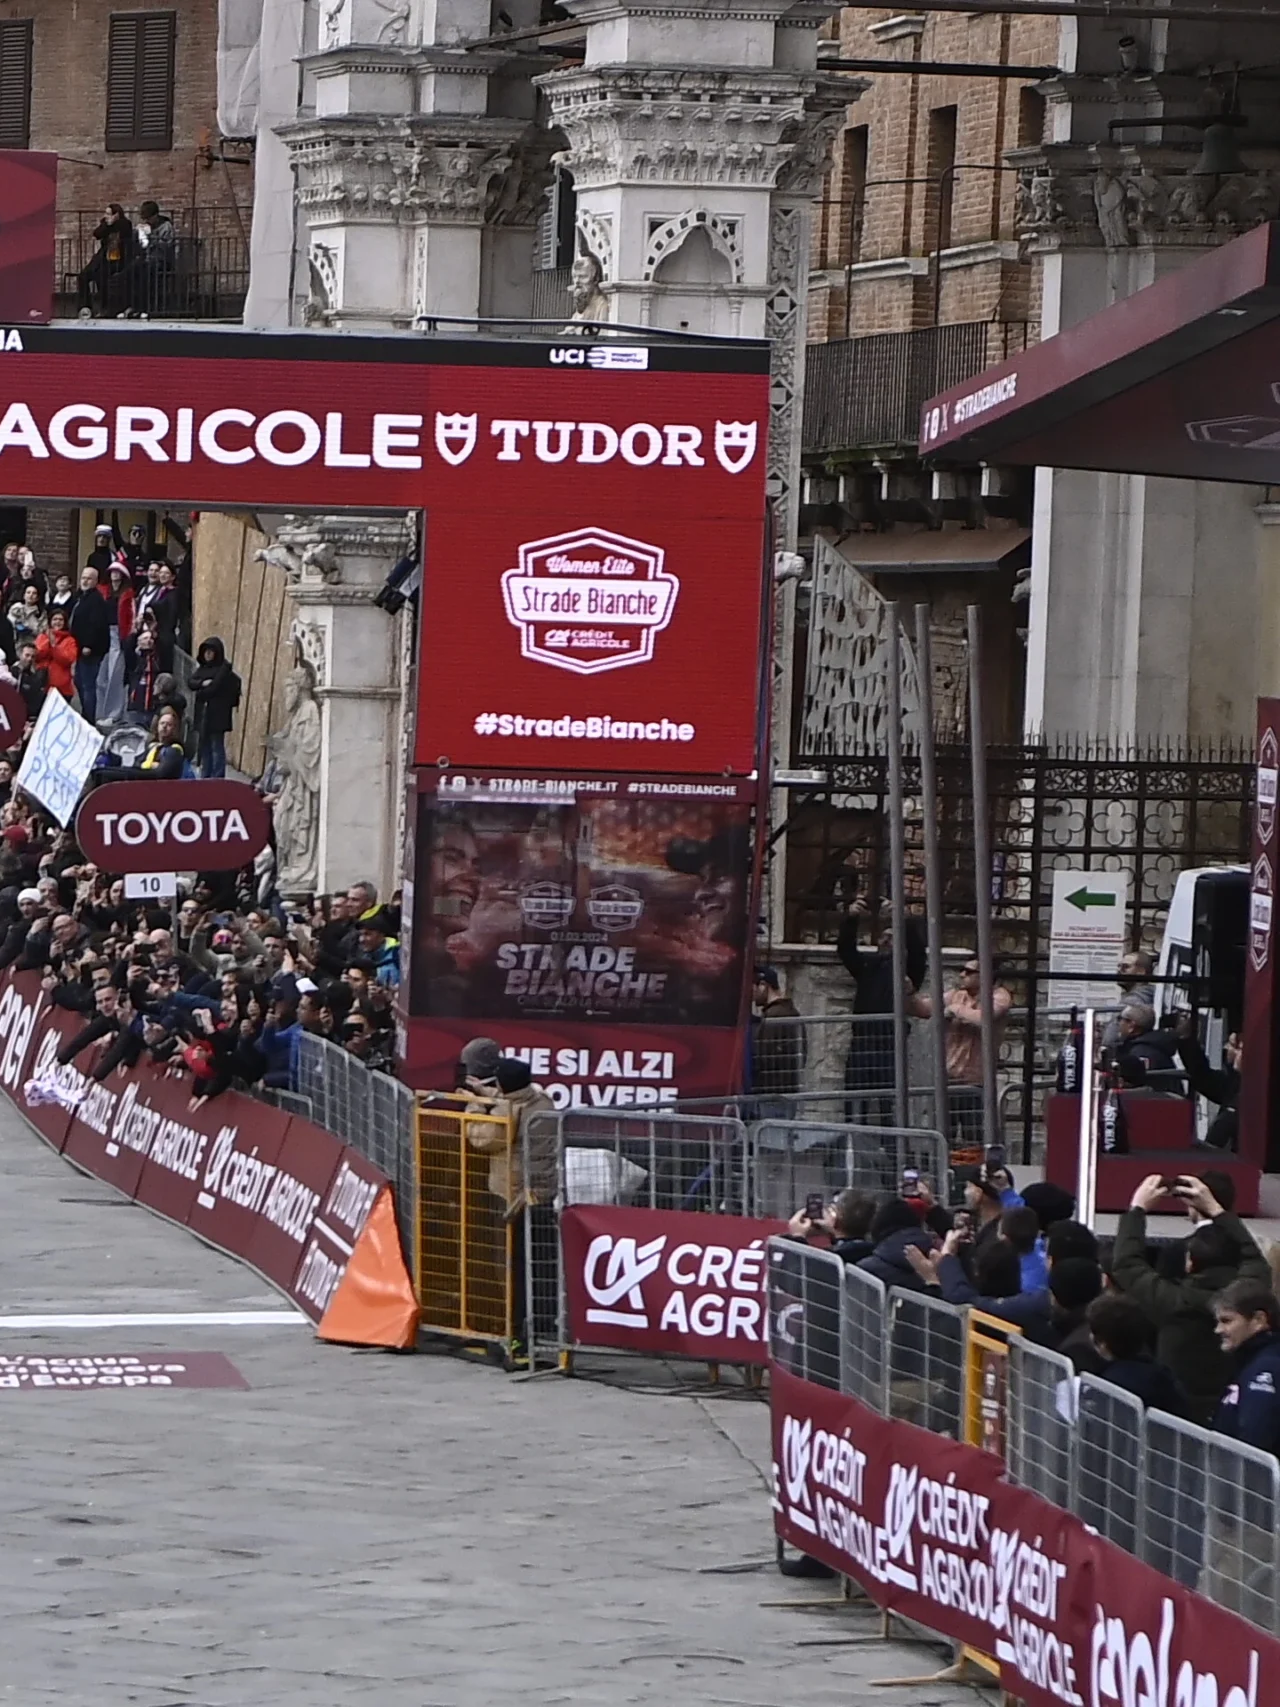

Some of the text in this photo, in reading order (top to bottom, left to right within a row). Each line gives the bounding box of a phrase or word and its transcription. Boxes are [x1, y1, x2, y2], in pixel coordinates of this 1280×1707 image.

[549, 348, 585, 364] UCI
[490, 419, 705, 466] TUDOR
[545, 554, 636, 576] Women Elite
[521, 585, 658, 616] Strade Bianche
[571, 628, 614, 639] CRÉDIT
[571, 638, 630, 649] AGRICOLE
[473, 712, 695, 741] #StradeBianche
[627, 781, 737, 796] #STRADEBIANCHE
[95, 809, 250, 846] TOYOTA
[139, 876, 162, 893] 10
[504, 968, 669, 999] BIANCHE
[499, 1047, 674, 1079] HE SI ALZI
[123, 1096, 161, 1155] CRÉDIT
[148, 1117, 208, 1181] AGRICOLE
[221, 1146, 276, 1213] CRÉDIT
[261, 1169, 321, 1244] AGRICOLE
[667, 1240, 768, 1292] CRÉ
[811, 1426, 867, 1506] CRÉDIT
[918, 1471, 990, 1549] CRÉDIT
[815, 1491, 889, 1584] AGRICOLE
